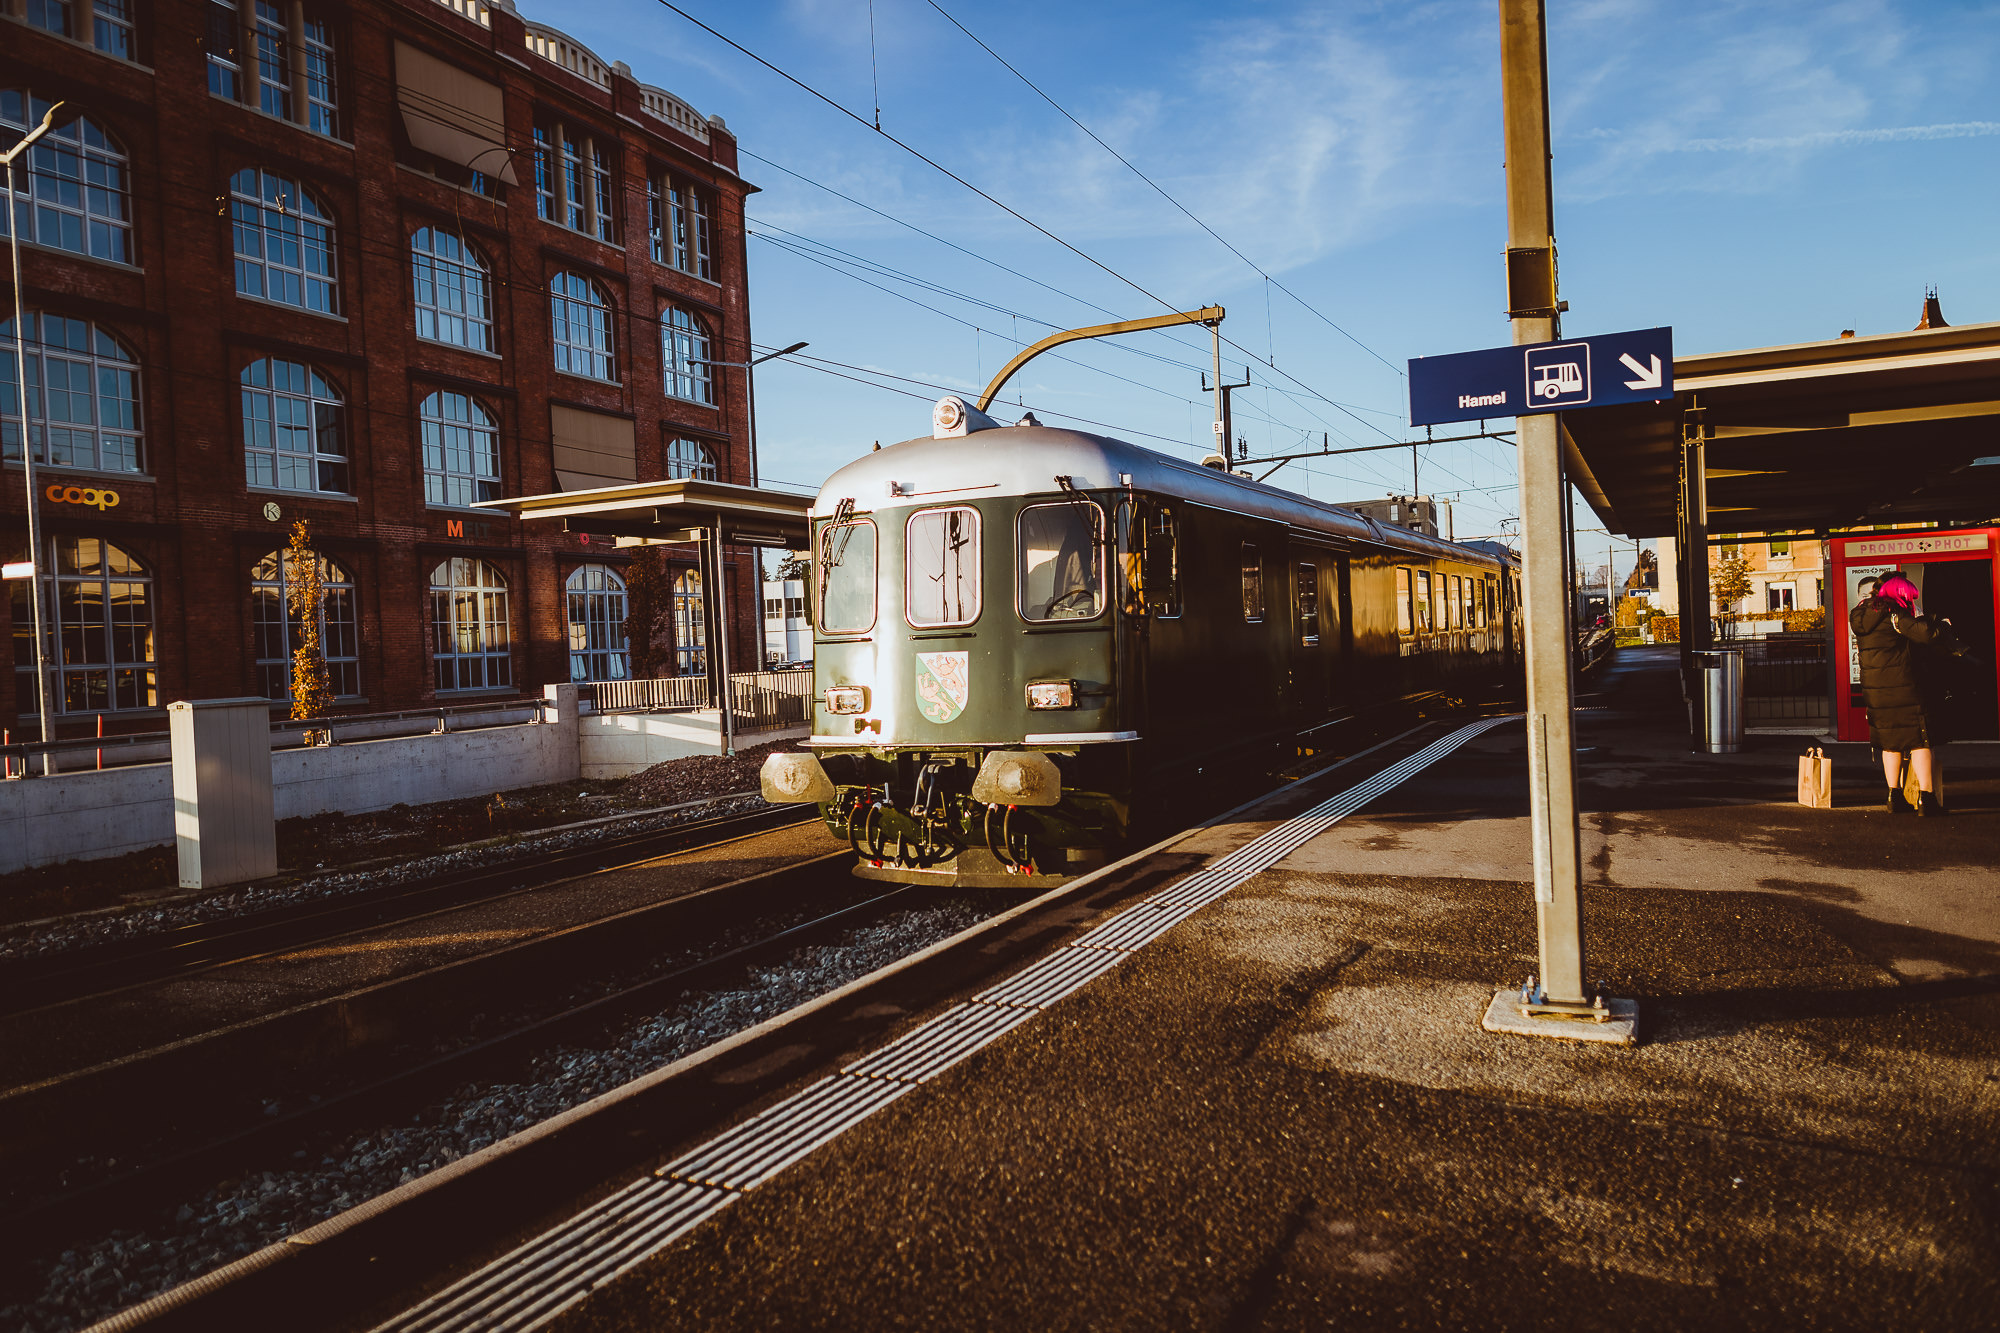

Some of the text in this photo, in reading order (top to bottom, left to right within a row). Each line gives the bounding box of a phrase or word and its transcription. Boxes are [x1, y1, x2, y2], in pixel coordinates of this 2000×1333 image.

[1458, 391, 1506, 409] Hamel
[46, 485, 120, 510] coop
[1860, 537, 1971, 554] PRONTO PHOT
